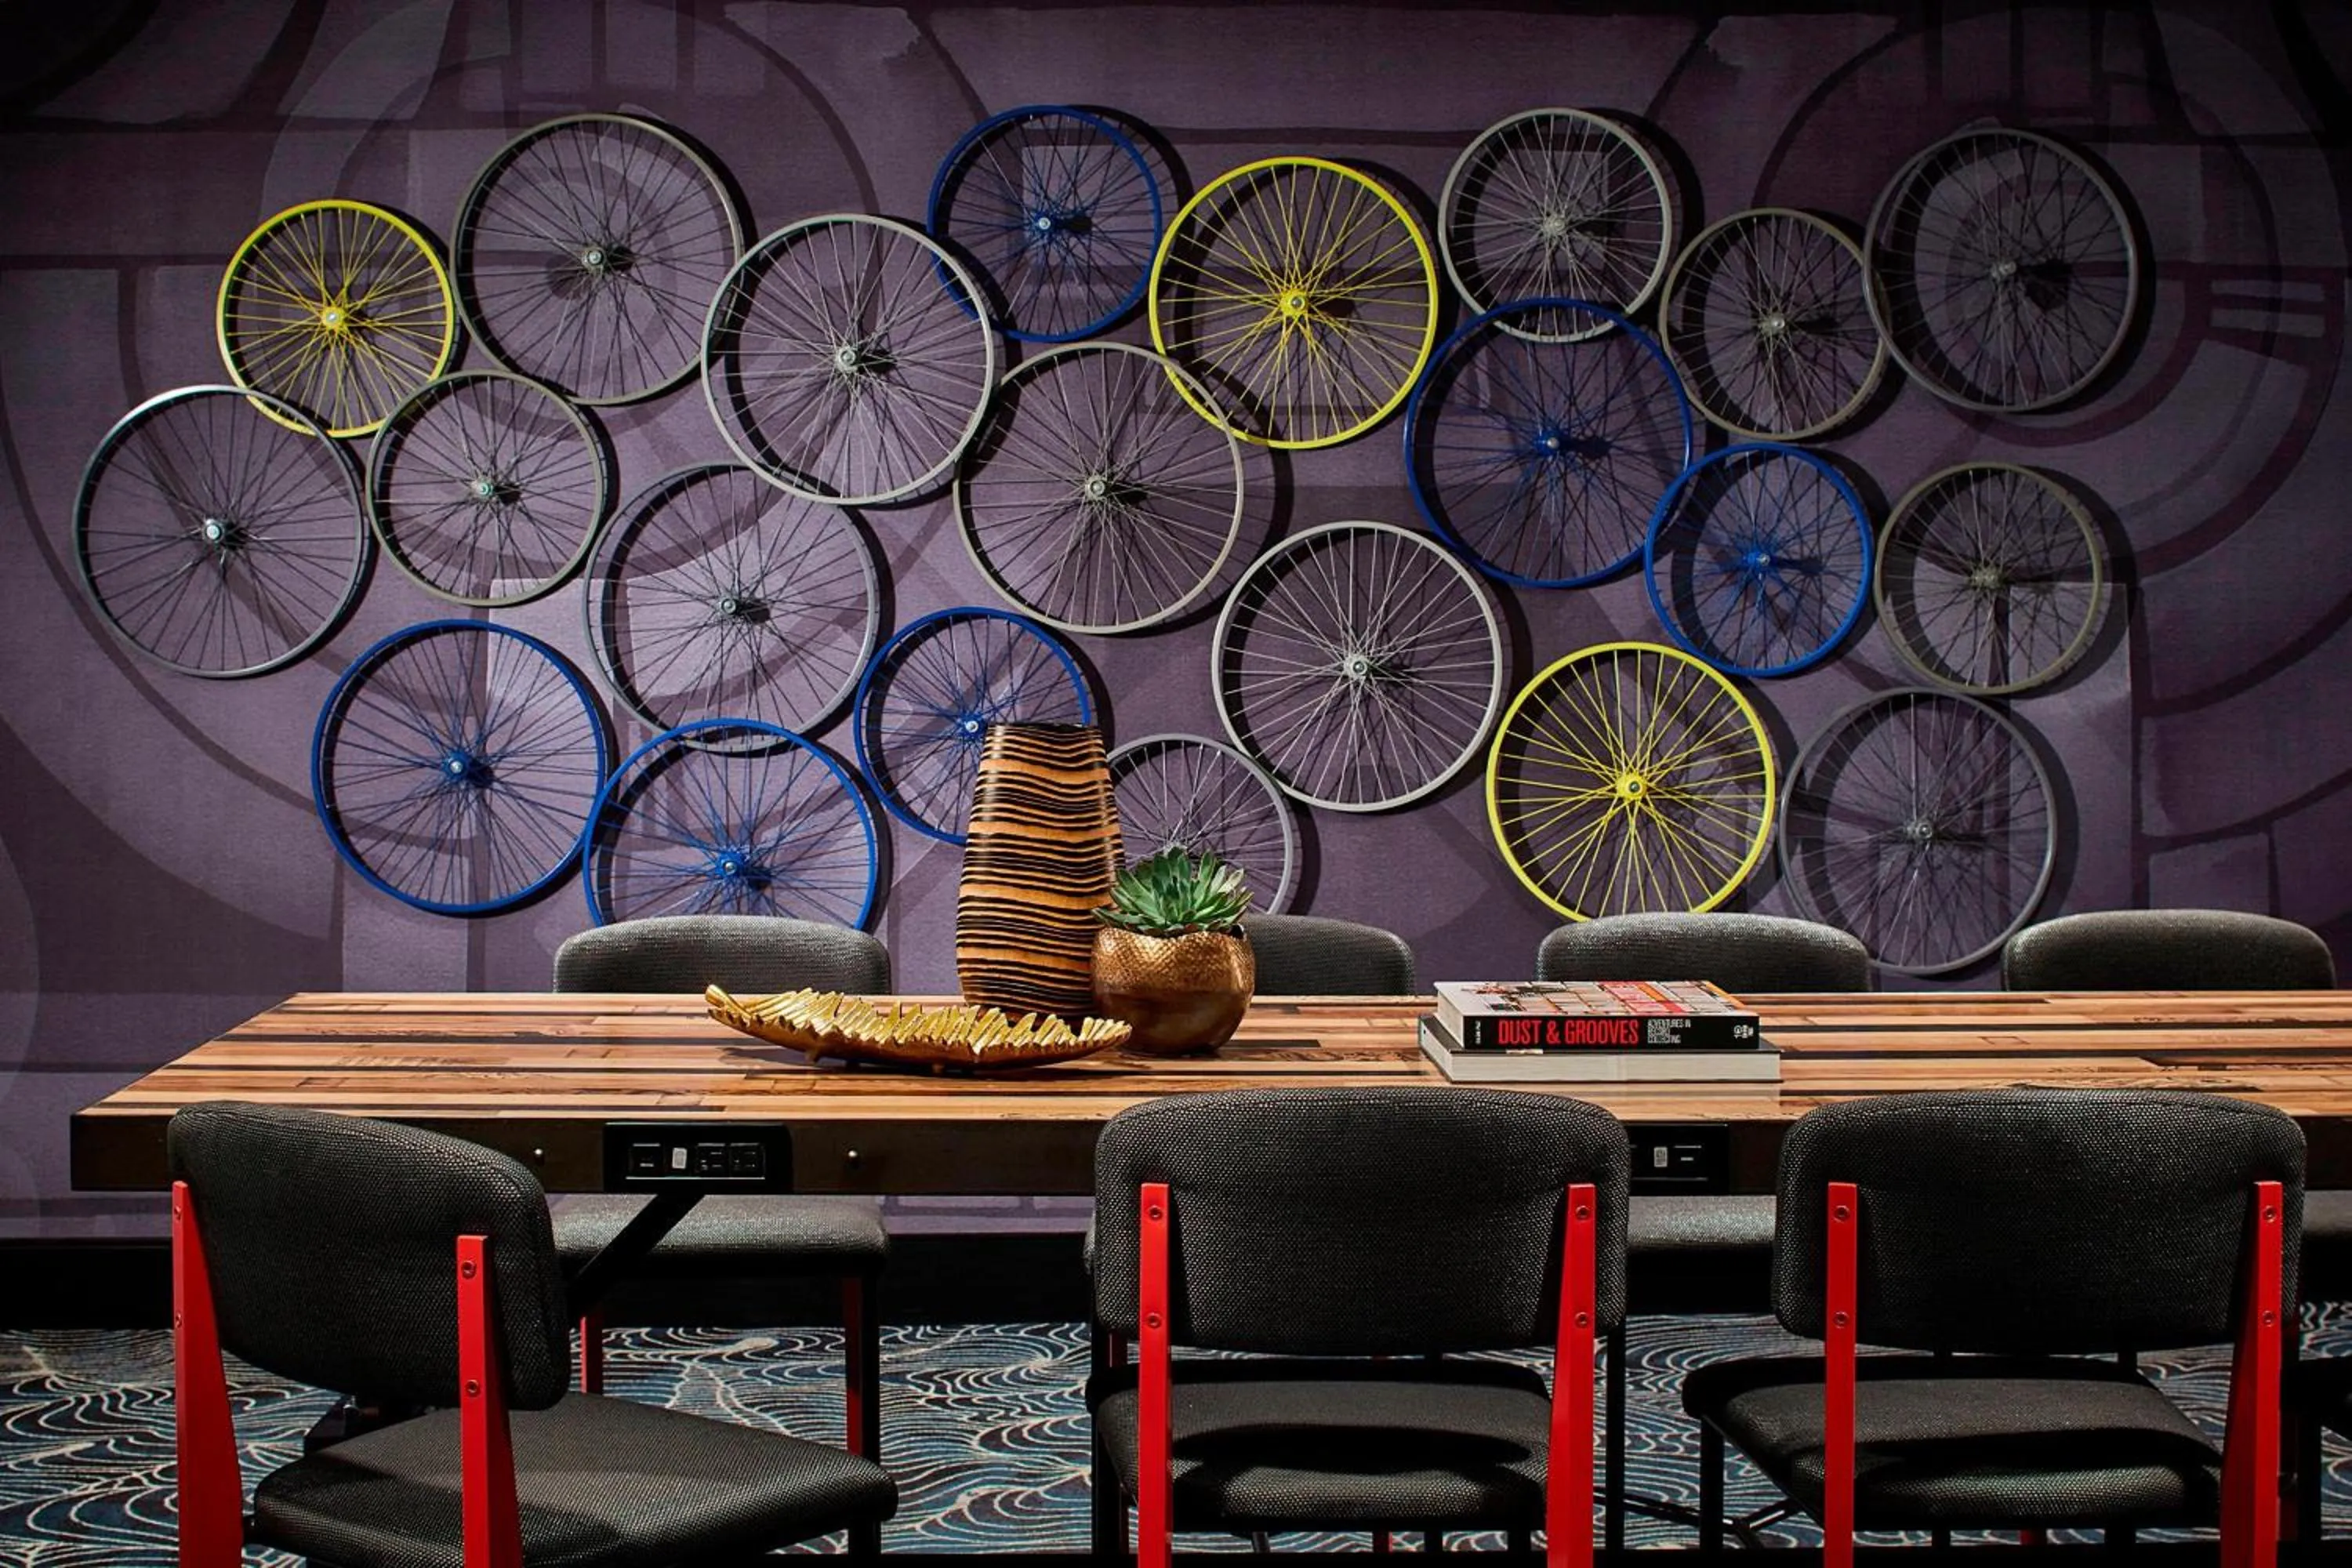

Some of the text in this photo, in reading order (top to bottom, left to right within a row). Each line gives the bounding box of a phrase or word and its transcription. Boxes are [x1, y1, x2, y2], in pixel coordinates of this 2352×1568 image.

[1498, 1020, 1541, 1044] DUST
[1546, 1020, 1560, 1044] &
[1565, 1020, 1639, 1044] GROOVES
